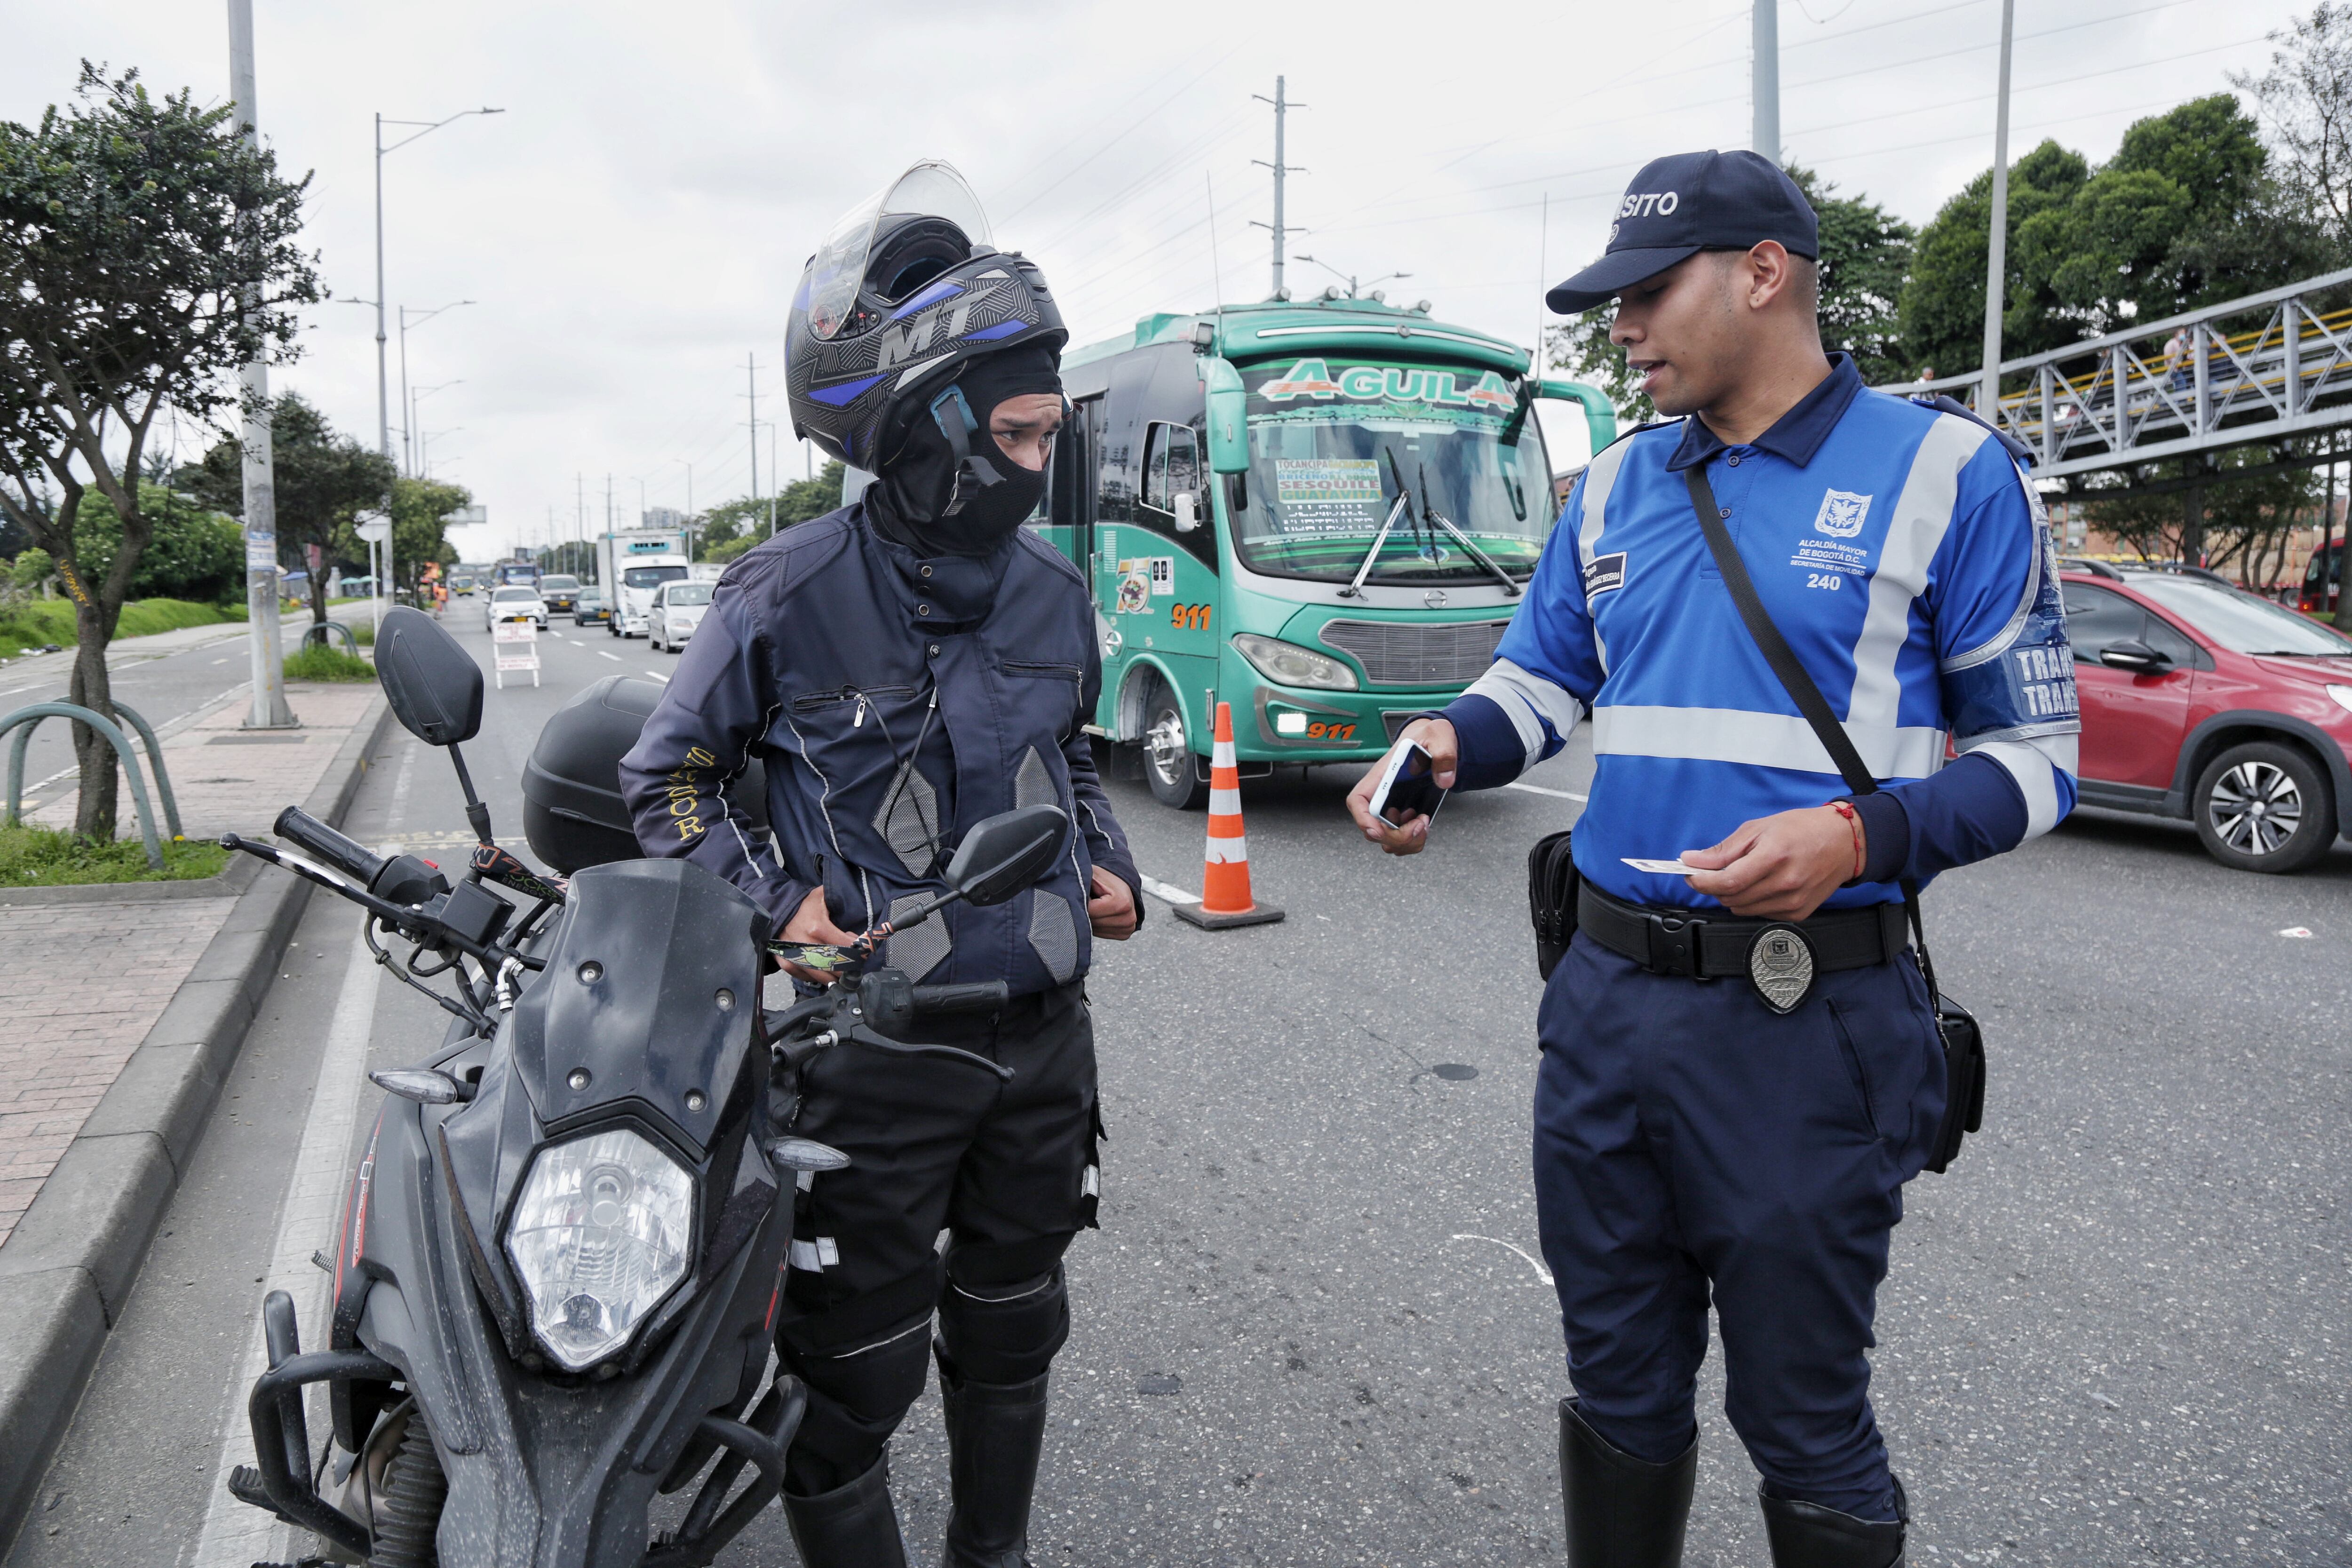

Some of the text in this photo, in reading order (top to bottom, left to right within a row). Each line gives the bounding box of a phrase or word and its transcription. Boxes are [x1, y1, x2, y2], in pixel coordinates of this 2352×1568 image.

[876, 285, 1001, 373] MT
[1257, 358, 1518, 413] AGUILA
[1281, 490, 1382, 500] GUATAVITA
[1799, 540, 1867, 557] ALCALDÍA MAYOR
[1811, 549, 1844, 560] BOGOTÁ
[1845, 555, 1860, 564] D.C.
[1790, 560, 1825, 569] SECRETARÍA
[1835, 565, 1865, 576] MOVILIDAD
[1806, 573, 1841, 591] 240
[1171, 603, 1212, 630] 911
[1306, 721, 1357, 740] 911
